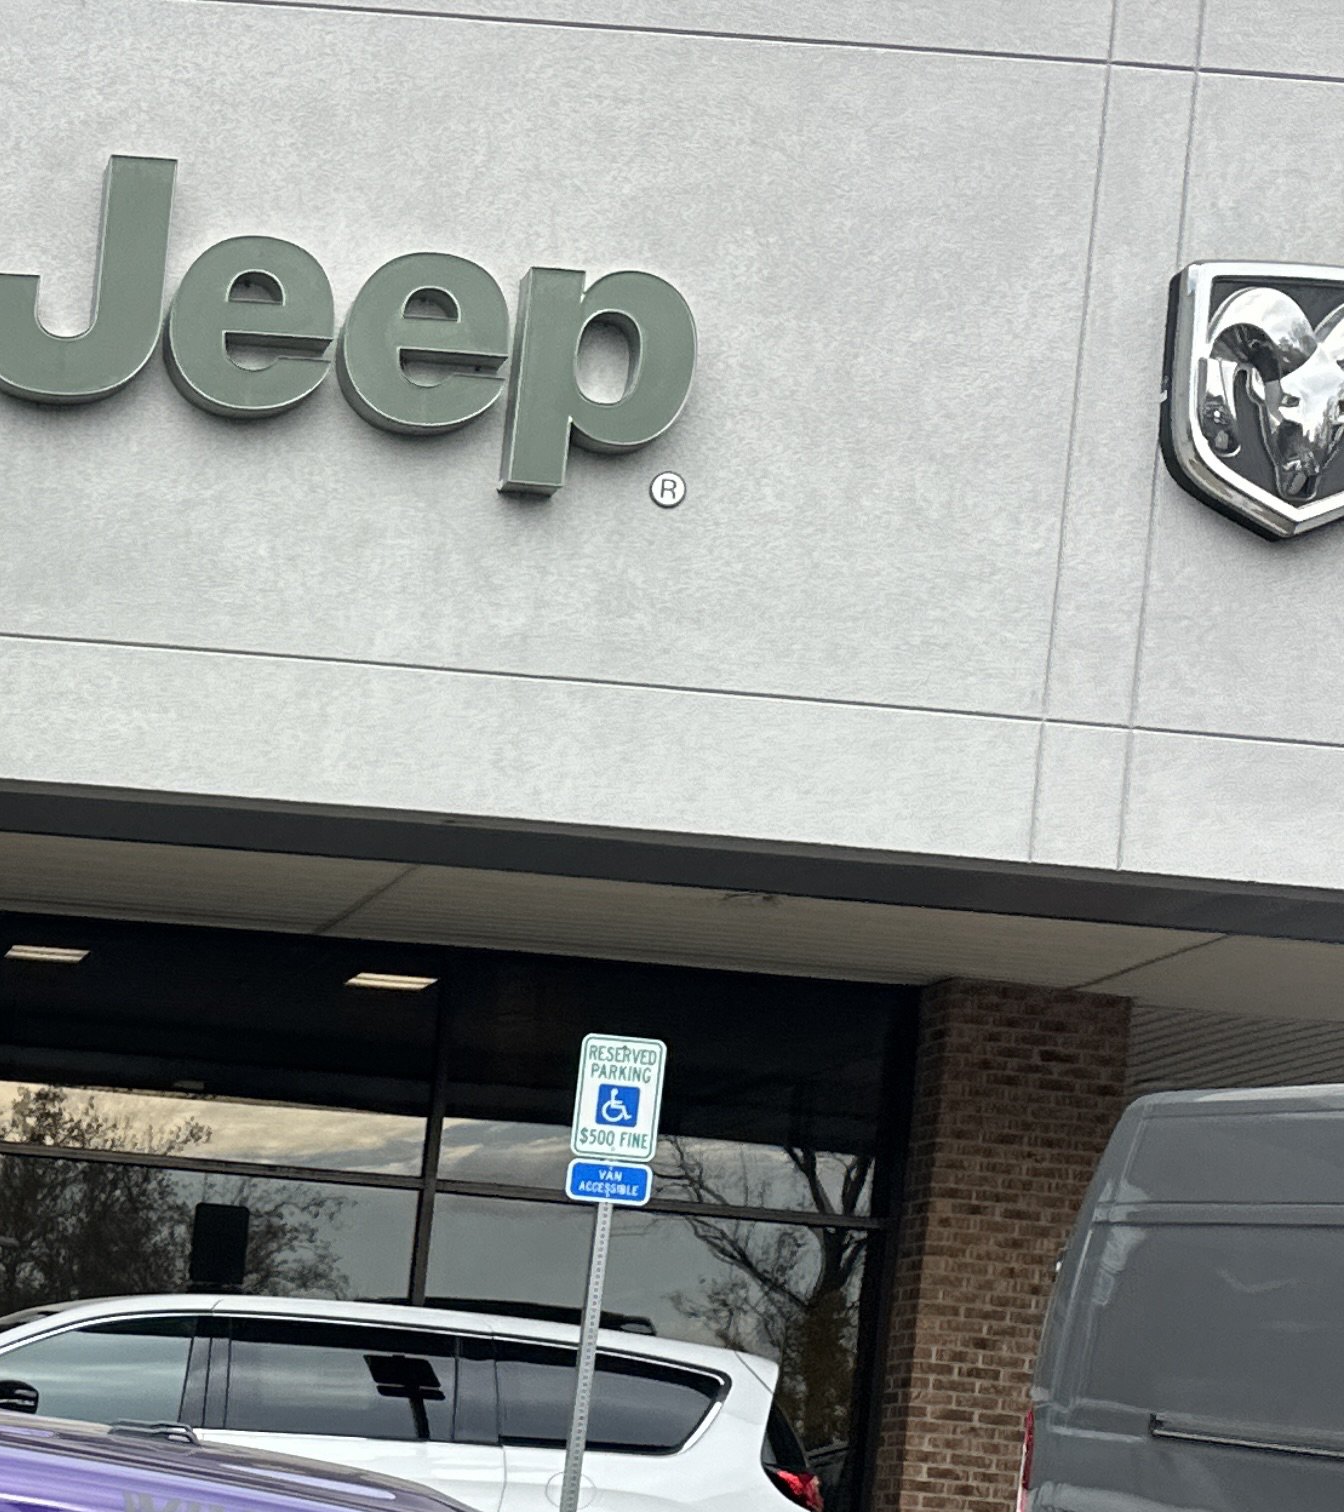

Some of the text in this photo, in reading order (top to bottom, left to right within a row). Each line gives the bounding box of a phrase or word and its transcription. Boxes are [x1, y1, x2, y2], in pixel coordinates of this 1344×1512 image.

[588, 1044, 658, 1066] RESERVED
[590, 1062, 652, 1084] PARKING
[578, 1127, 649, 1150] $500 FINE
[598, 1168, 623, 1182] VAN
[578, 1181, 640, 1197] ACCESSIBLE
